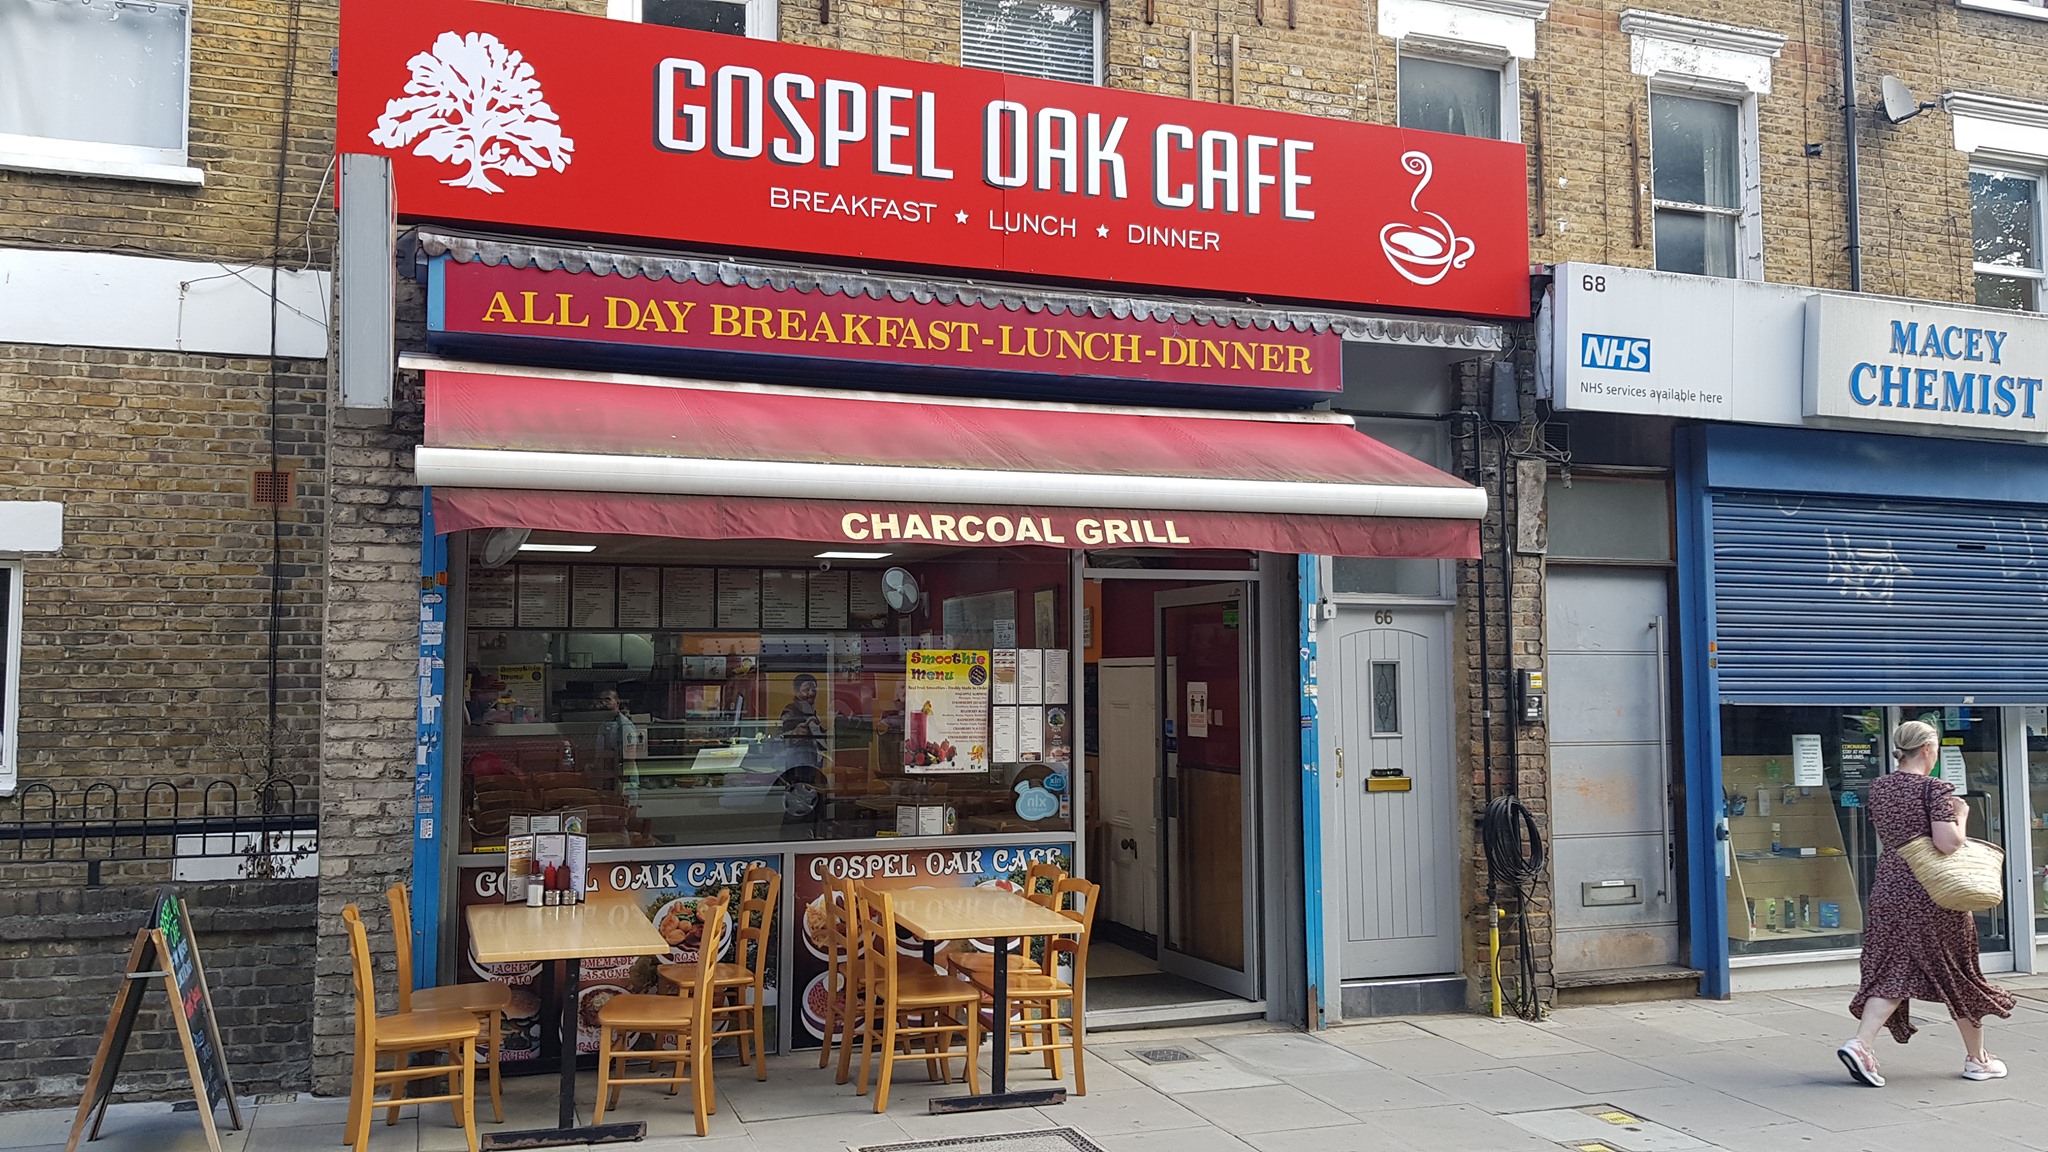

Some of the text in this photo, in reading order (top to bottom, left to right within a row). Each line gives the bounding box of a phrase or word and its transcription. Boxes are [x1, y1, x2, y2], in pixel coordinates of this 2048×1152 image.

[654, 57, 1316, 221] GOSPEL OAK CAFE
[770, 187, 1221, 252] BREAKFAST LUNCH DINNER
[1582, 274, 1606, 293] 68
[482, 291, 590, 327] ALL
[603, 296, 697, 334] DAY
[1583, 336, 1649, 370] NHS
[1890, 320, 2008, 365] MACEY
[1580, 381, 1723, 404] NHS services available here
[1848, 361, 2043, 419] CHEMIST
[841, 512, 1190, 545] CHARCOAL GRILL
[1374, 609, 1393, 625] 66
[911, 651, 986, 665] Smoothie
[926, 850, 984, 876] OAK
[609, 864, 677, 892] OAK
[489, 962, 533, 974] JACKET
[580, 956, 634, 968] OMEMADE
[674, 952, 699, 962] ROA
[580, 968, 630, 980] ASAGNE
